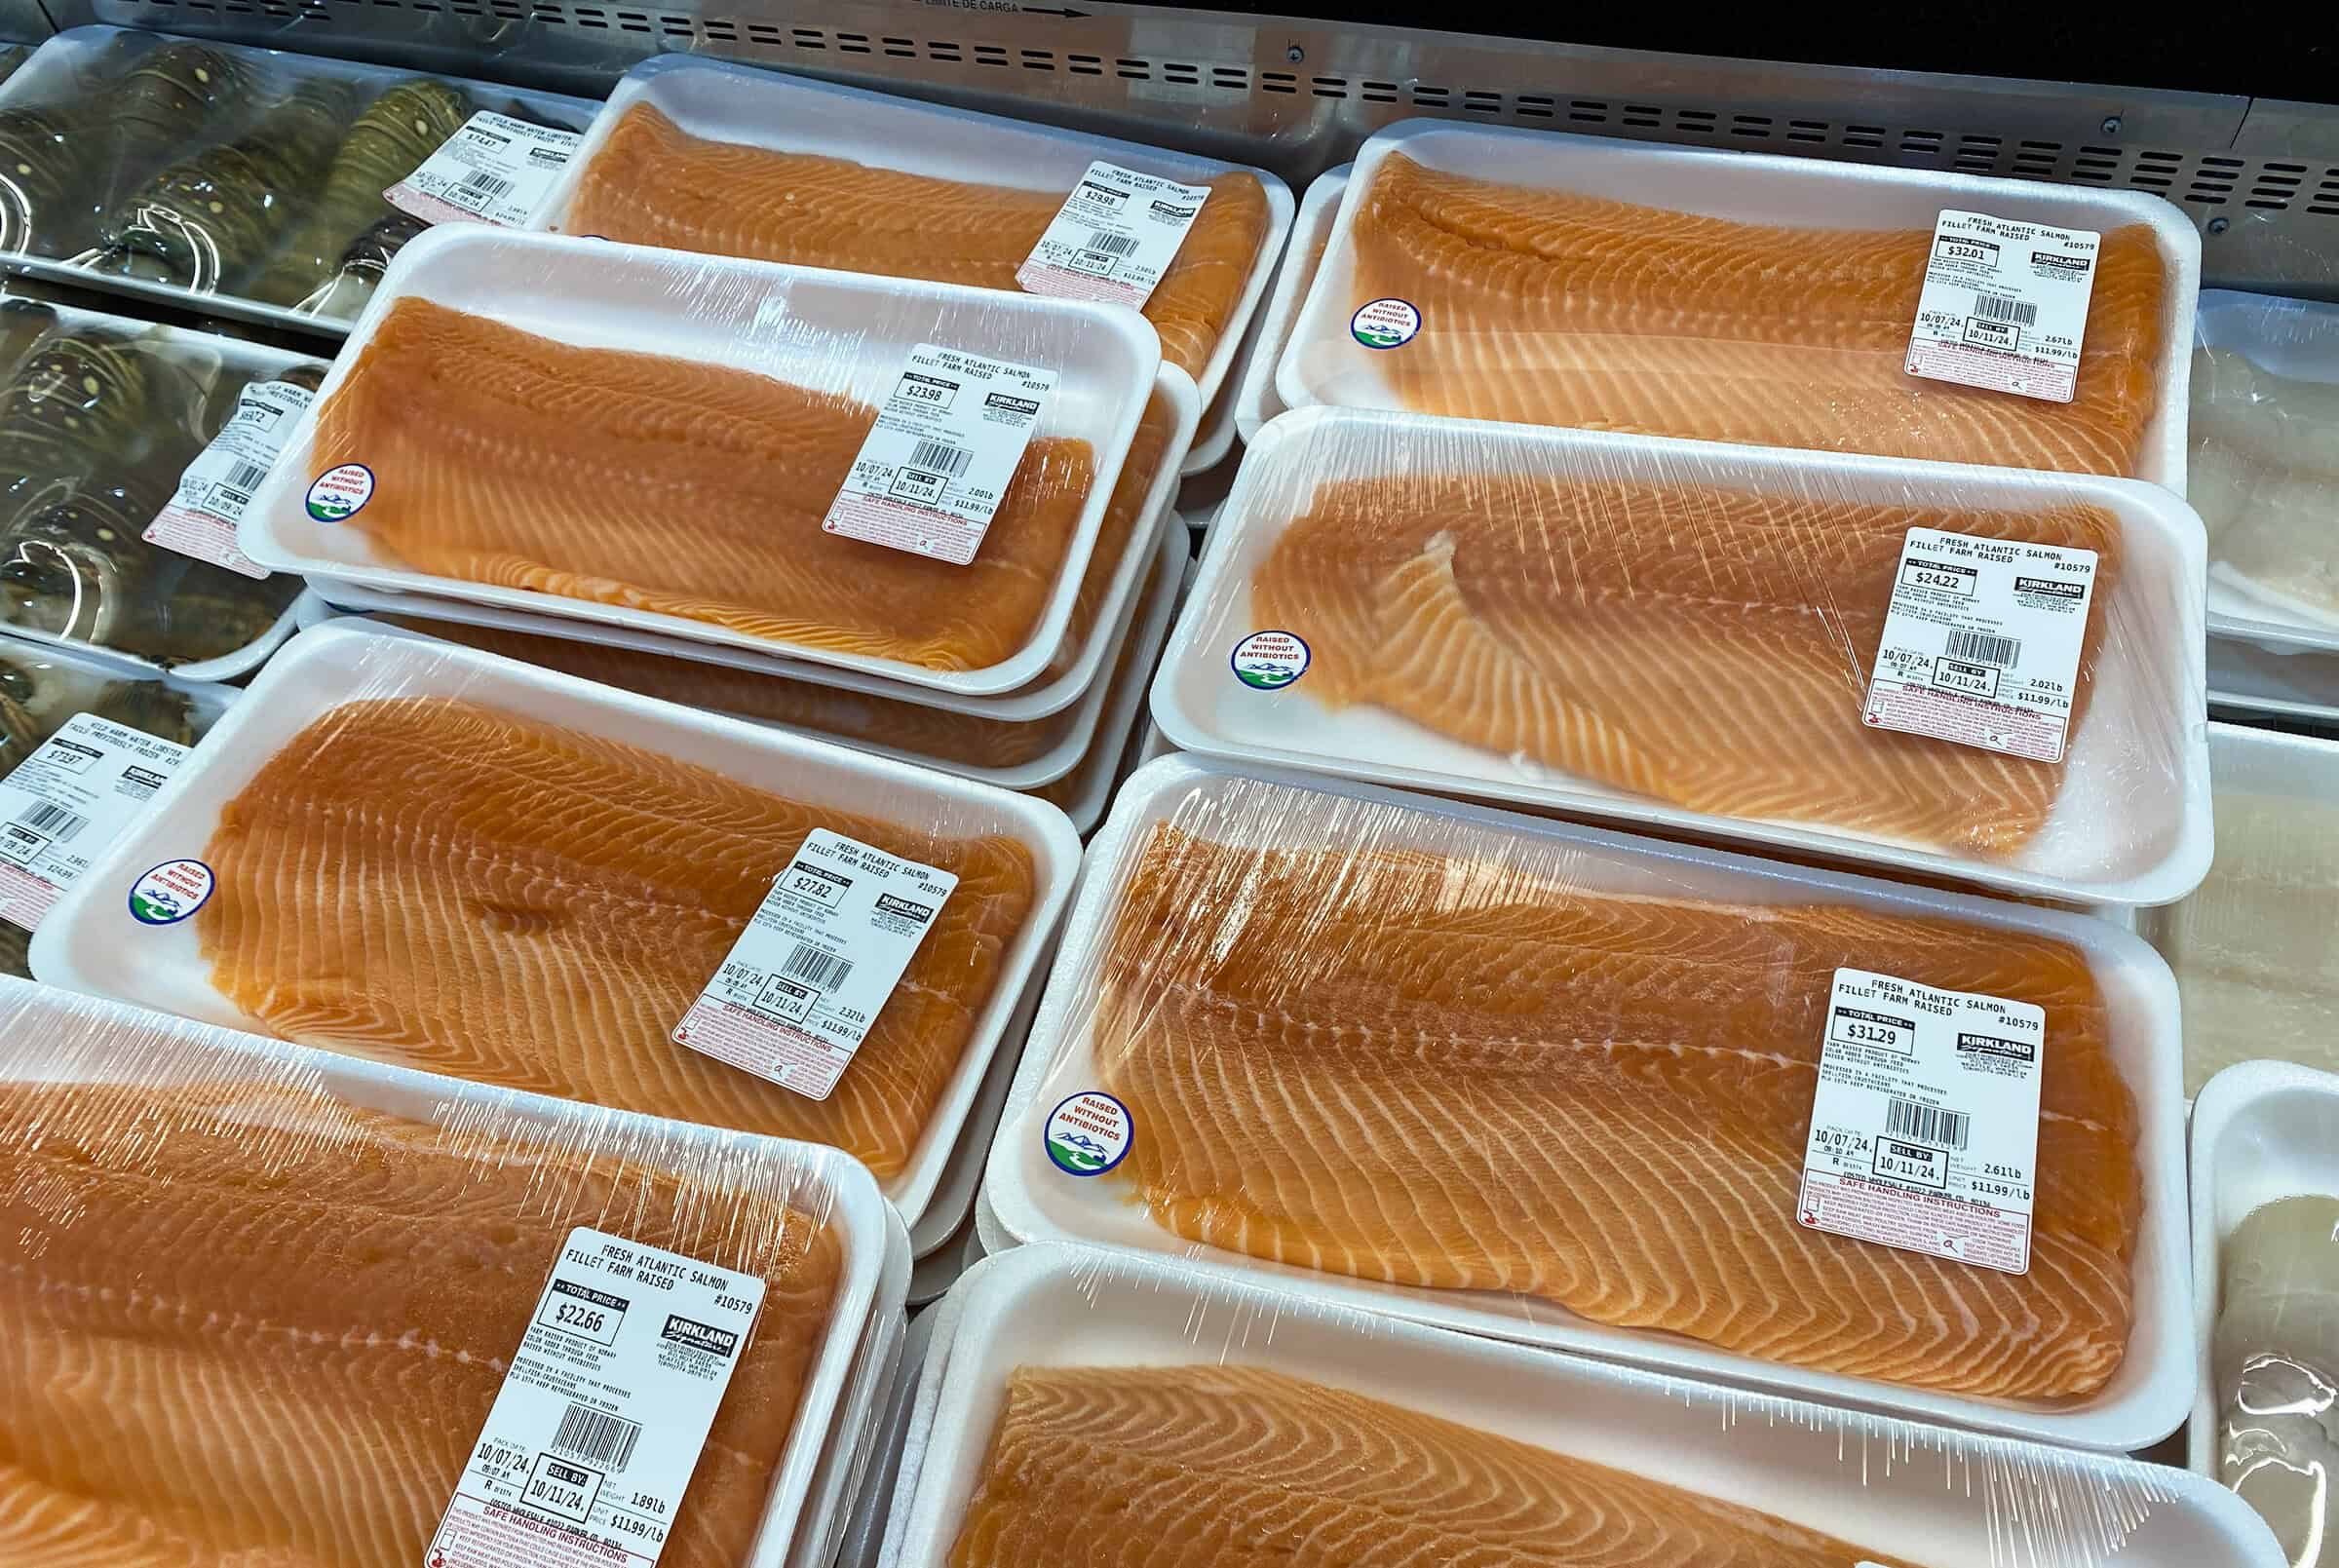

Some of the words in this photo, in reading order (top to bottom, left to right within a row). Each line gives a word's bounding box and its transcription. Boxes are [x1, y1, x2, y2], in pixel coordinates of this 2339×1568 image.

[979, 1, 1018, 12] CARGA
[1085, 191, 1115, 206] $29.98
[1942, 220, 1972, 230] FILLET
[1976, 225, 1996, 235] FARM
[2000, 230, 2029, 241] RAISED
[1968, 217, 1992, 226] FRESH
[1997, 223, 2036, 235] ATLANTIC
[2041, 230, 2070, 241] SALMON
[1947, 247, 1984, 260] $32.01
[2035, 253, 2088, 266] KIRKLAND
[1361, 314, 1410, 325] ANTIBIOTICS
[1373, 309, 1408, 319] WITHOUT
[2035, 347, 2078, 359] $11.99/lb
[912, 356, 939, 366] FILLET
[965, 367, 992, 379] RAISED
[938, 353, 960, 363] FRESH
[965, 359, 1001, 373] ATLANTIC
[1004, 367, 1030, 378] SALMON
[906, 386, 942, 402] $23.98
[1021, 382, 1050, 391] #10579
[989, 395, 1037, 410] KIRKLAND
[320, 482, 364, 495] ANTIBIOTICS
[331, 476, 364, 485] WITHOUT
[968, 487, 993, 499] 2.00lb
[954, 500, 993, 515] $11.99/lb
[1910, 540, 1943, 553] FILLET
[1949, 547, 1973, 557] FARM
[1978, 552, 2013, 563] RAISED
[1940, 537, 1969, 548] FRESH
[1975, 543, 2020, 555] ATLANTIC
[2027, 550, 2062, 561] SALMON
[1918, 560, 1941, 570] TOTAL
[2054, 562, 2090, 573] #10579
[1916, 572, 1959, 589] $24.22
[2019, 579, 2082, 593] KIRKLAND
[1241, 651, 1298, 660] ANTIBIOTICS
[2030, 679, 2062, 692] 2.02lb
[1902, 686, 1925, 695] SAFE
[1927, 690, 1974, 707] HANDLING
[1975, 700, 2042, 719] INSTRUCTIONS
[2017, 693, 2069, 708] $11.99/lb
[807, 842, 835, 858] FILLET
[838, 854, 858, 865] FARM
[861, 862, 889, 878] RAISED
[834, 842, 859, 857] FRESH
[863, 852, 901, 872] ATLANTIC
[902, 866, 929, 879] SALMON
[168, 869, 202, 888] WITHOUT
[177, 863, 205, 879] RAISED
[151, 874, 199, 899] ANTIBIOTICS
[793, 877, 831, 899] $27.82
[918, 882, 947, 897] #10579
[882, 896, 930, 915] KIRKLAND
[1839, 984, 1876, 998] FILLET
[1883, 992, 1908, 1005] FARM
[1914, 999, 1952, 1016] RAISED
[1872, 980, 1903, 993] FRESH
[1909, 988, 1960, 1007] ATLANTIC
[1967, 1000, 2006, 1013] SALMON
[839, 1007, 865, 1022] 2.32lb
[1849, 1011, 1875, 1021] TOTAL
[1877, 1016, 1901, 1025] PRICE
[1998, 1016, 2039, 1030] #10579
[722, 1005, 742, 1016] SAFE
[743, 1011, 779, 1031] HANDLING
[780, 1027, 832, 1052] INSTRUCTIONS
[822, 1020, 862, 1041] $11.99/lb
[1848, 1025, 1896, 1045] $31.29
[1962, 1036, 2032, 1053] KIRKLAND
[1083, 1097, 1118, 1115] RAISED
[1074, 1106, 1119, 1127] WITHOUT
[1058, 1113, 1121, 1140] ANTIBIOTICS
[1892, 1145, 1914, 1158] SELL
[1984, 1164, 2021, 1179] 2.61lb
[1839, 1178, 1864, 1190] SAFE
[1866, 1183, 1920, 1202] HANDLING
[1923, 1194, 2001, 1217] INSTRUCTIONS
[1972, 1181, 2030, 1200] $11.99/lb
[566, 1249, 603, 1269] FILLET
[607, 1262, 633, 1279] FARM
[636, 1270, 674, 1291] RAISED
[601, 1244, 633, 1262] FRESH
[636, 1255, 686, 1279] ATLANTIC
[690, 1271, 729, 1291] SALMON
[566, 1283, 591, 1300] TOTAL
[592, 1292, 617, 1307] PRICE
[714, 1294, 752, 1315] #10579
[556, 1302, 605, 1333] $22.66
[669, 1318, 733, 1346] KIRKLAND
[548, 1465, 571, 1480] SELL
[631, 1493, 665, 1513] 1.89lb
[483, 1507, 508, 1522] SAFE
[509, 1512, 556, 1539] HANDLING
[558, 1527, 629, 1563] INSTRUCTIONS
[610, 1514, 664, 1543] $11.99/lb
